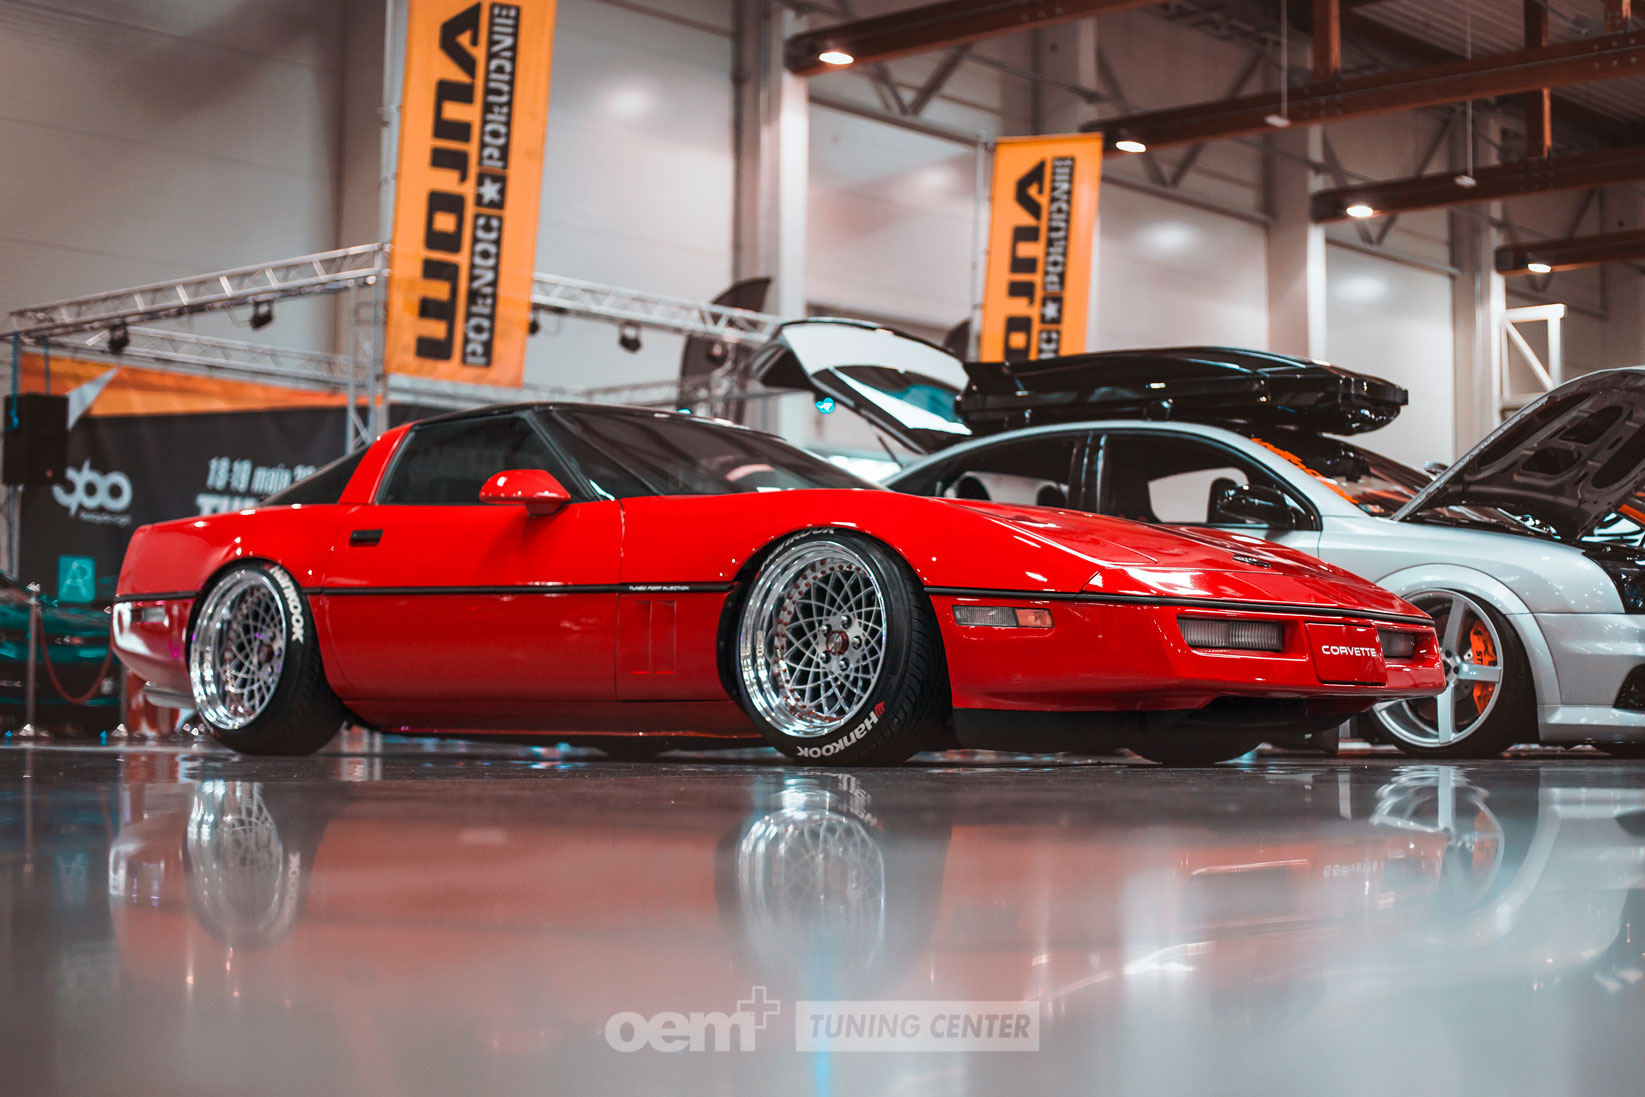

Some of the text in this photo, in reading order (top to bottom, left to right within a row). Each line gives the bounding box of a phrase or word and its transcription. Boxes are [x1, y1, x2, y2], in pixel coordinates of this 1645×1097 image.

[415, 2, 482, 360] WOJNA
[1004, 159, 1045, 361] OJNA
[1321, 645, 1377, 658] CORVETTE
